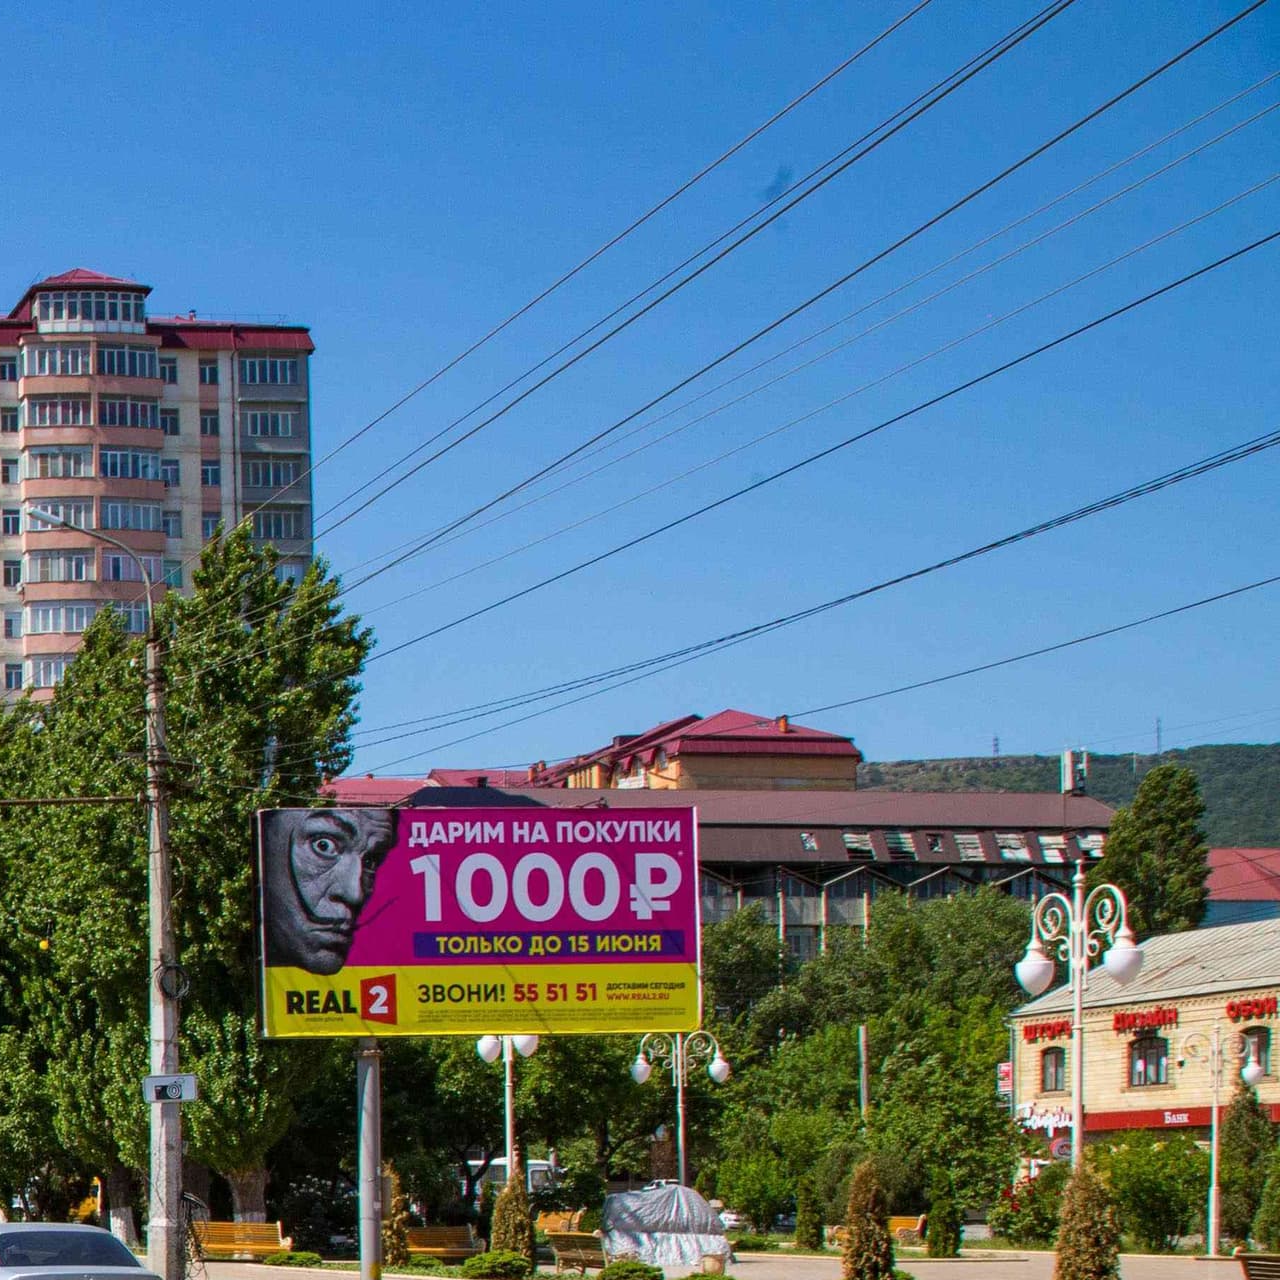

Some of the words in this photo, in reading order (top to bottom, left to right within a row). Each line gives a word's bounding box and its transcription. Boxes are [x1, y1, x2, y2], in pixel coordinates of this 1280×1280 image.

[408, 820, 505, 848] ДАРИМ
[512, 820, 550, 844] НА
[556, 820, 682, 844] ПОКУПКИ
[436, 935, 523, 955] ТОЛЬКО
[528, 935, 562, 956] ДО
[567, 935, 590, 952] 15
[596, 934, 662, 952] ИЮНЯ
[286, 990, 358, 1015] REAL
[368, 983, 389, 1015] 2
[417, 983, 506, 1003] ЗВОНИ!
[512, 982, 539, 1002] 55
[545, 982, 569, 1001] 51
[575, 982, 598, 1001] 51
[1112, 1005, 1179, 1032] ДИЗАЙН
